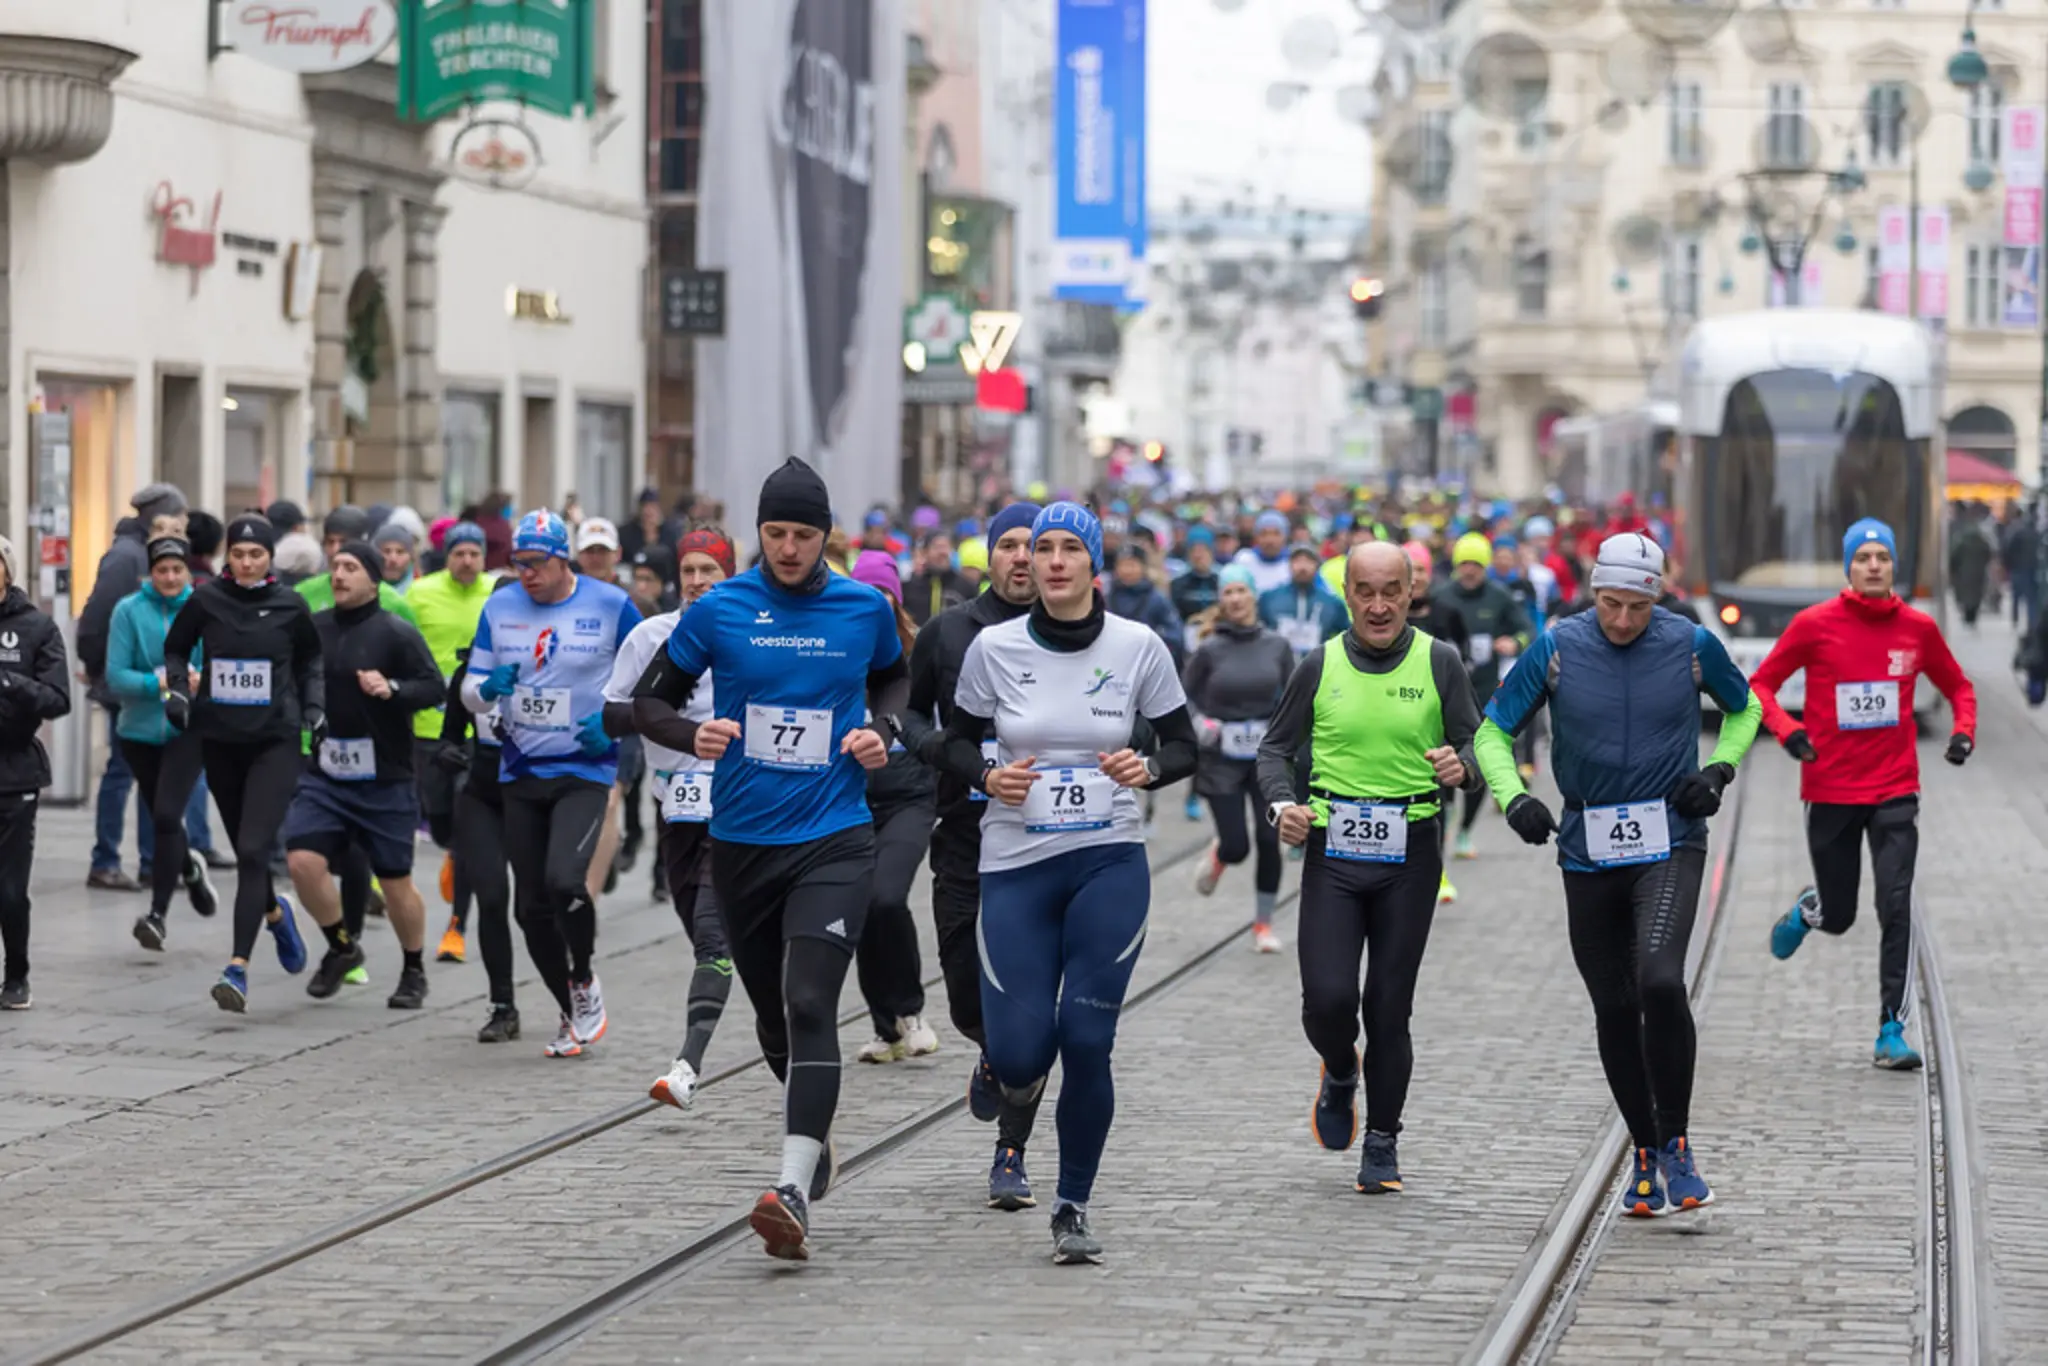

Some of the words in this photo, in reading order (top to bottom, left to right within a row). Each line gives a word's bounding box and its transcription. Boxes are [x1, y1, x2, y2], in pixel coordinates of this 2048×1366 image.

[241, 5, 377, 60] Triumph
[749, 635, 826, 651] voestalpine
[218, 672, 263, 689] 1188
[1399, 687, 1424, 699] BSV
[522, 698, 557, 714] 557
[1849, 694, 1886, 712] 329
[1091, 706, 1123, 718] Verena
[771, 724, 806, 747] 77
[675, 786, 701, 802] 93
[1049, 785, 1085, 807] 78
[1342, 818, 1389, 840] 238
[1609, 821, 1642, 842] 43
